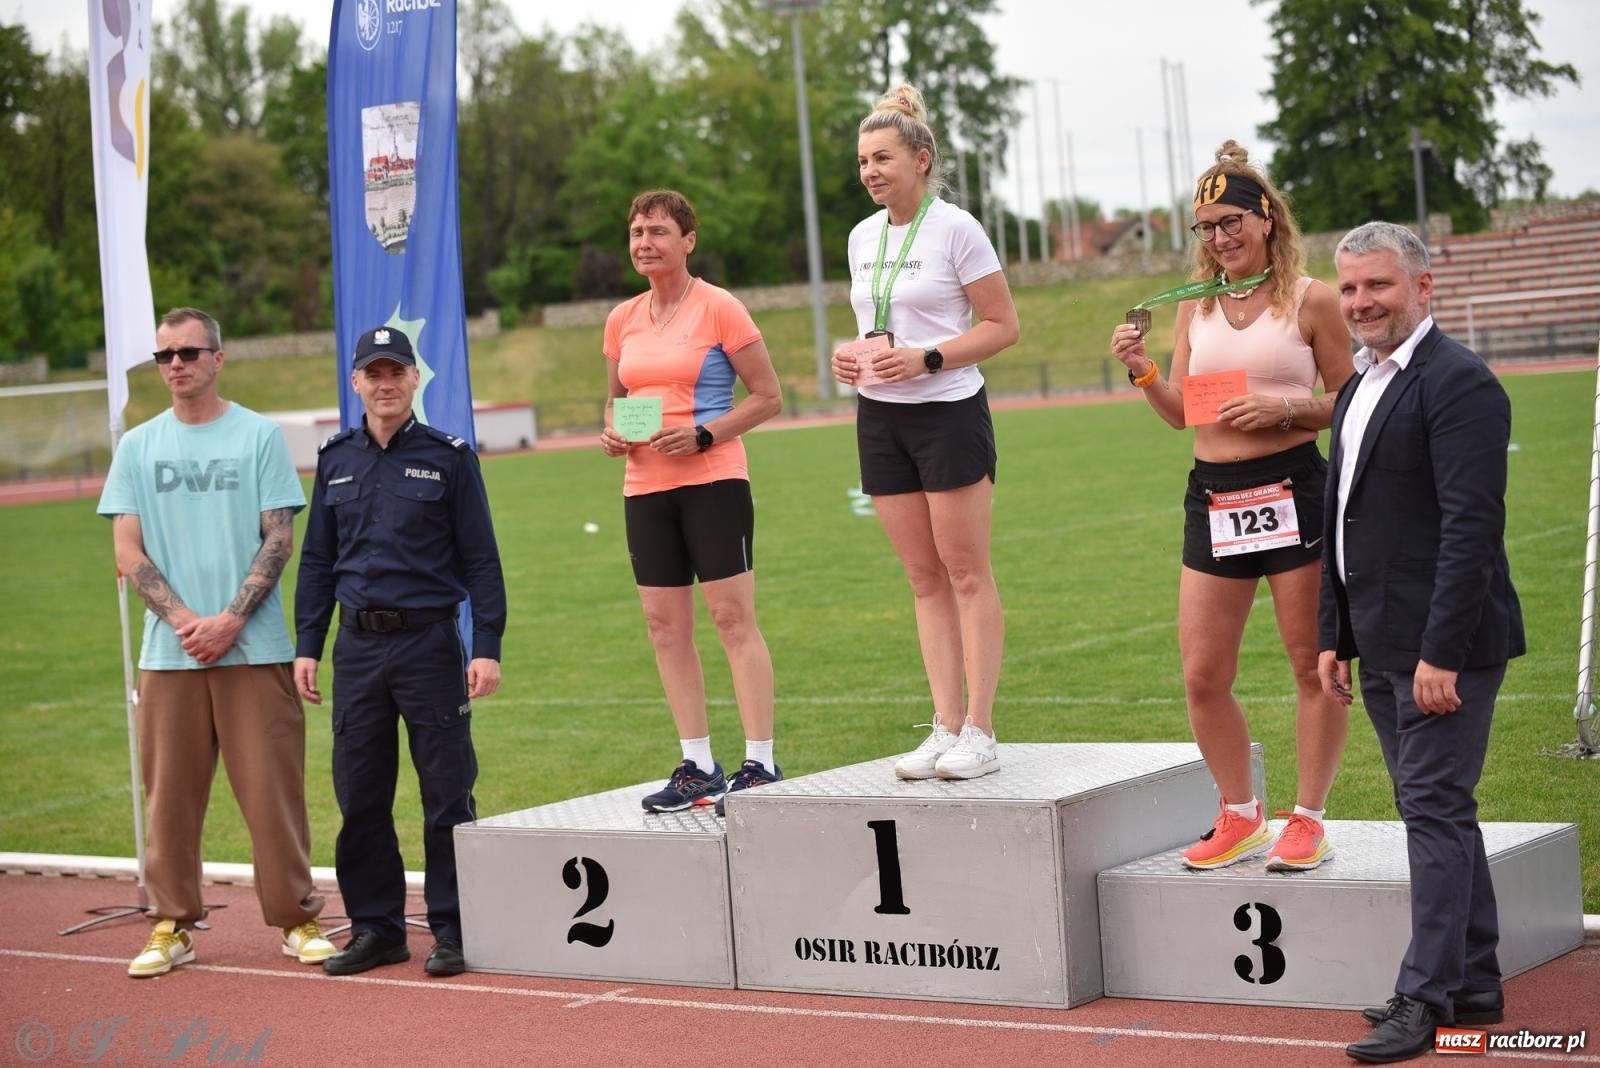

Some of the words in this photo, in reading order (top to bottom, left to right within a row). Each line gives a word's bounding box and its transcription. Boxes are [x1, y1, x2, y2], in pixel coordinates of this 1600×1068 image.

[405, 467, 441, 481] POLICJA
[1240, 491, 1253, 499] BEZ
[1253, 486, 1280, 496] GRANIC
[1229, 506, 1279, 537] 123
[867, 819, 911, 915] 1
[562, 856, 615, 948] 2
[794, 937, 857, 964] OSIR
[863, 938, 1001, 971] RACIBÓRZ
[1233, 902, 1286, 985] 3
